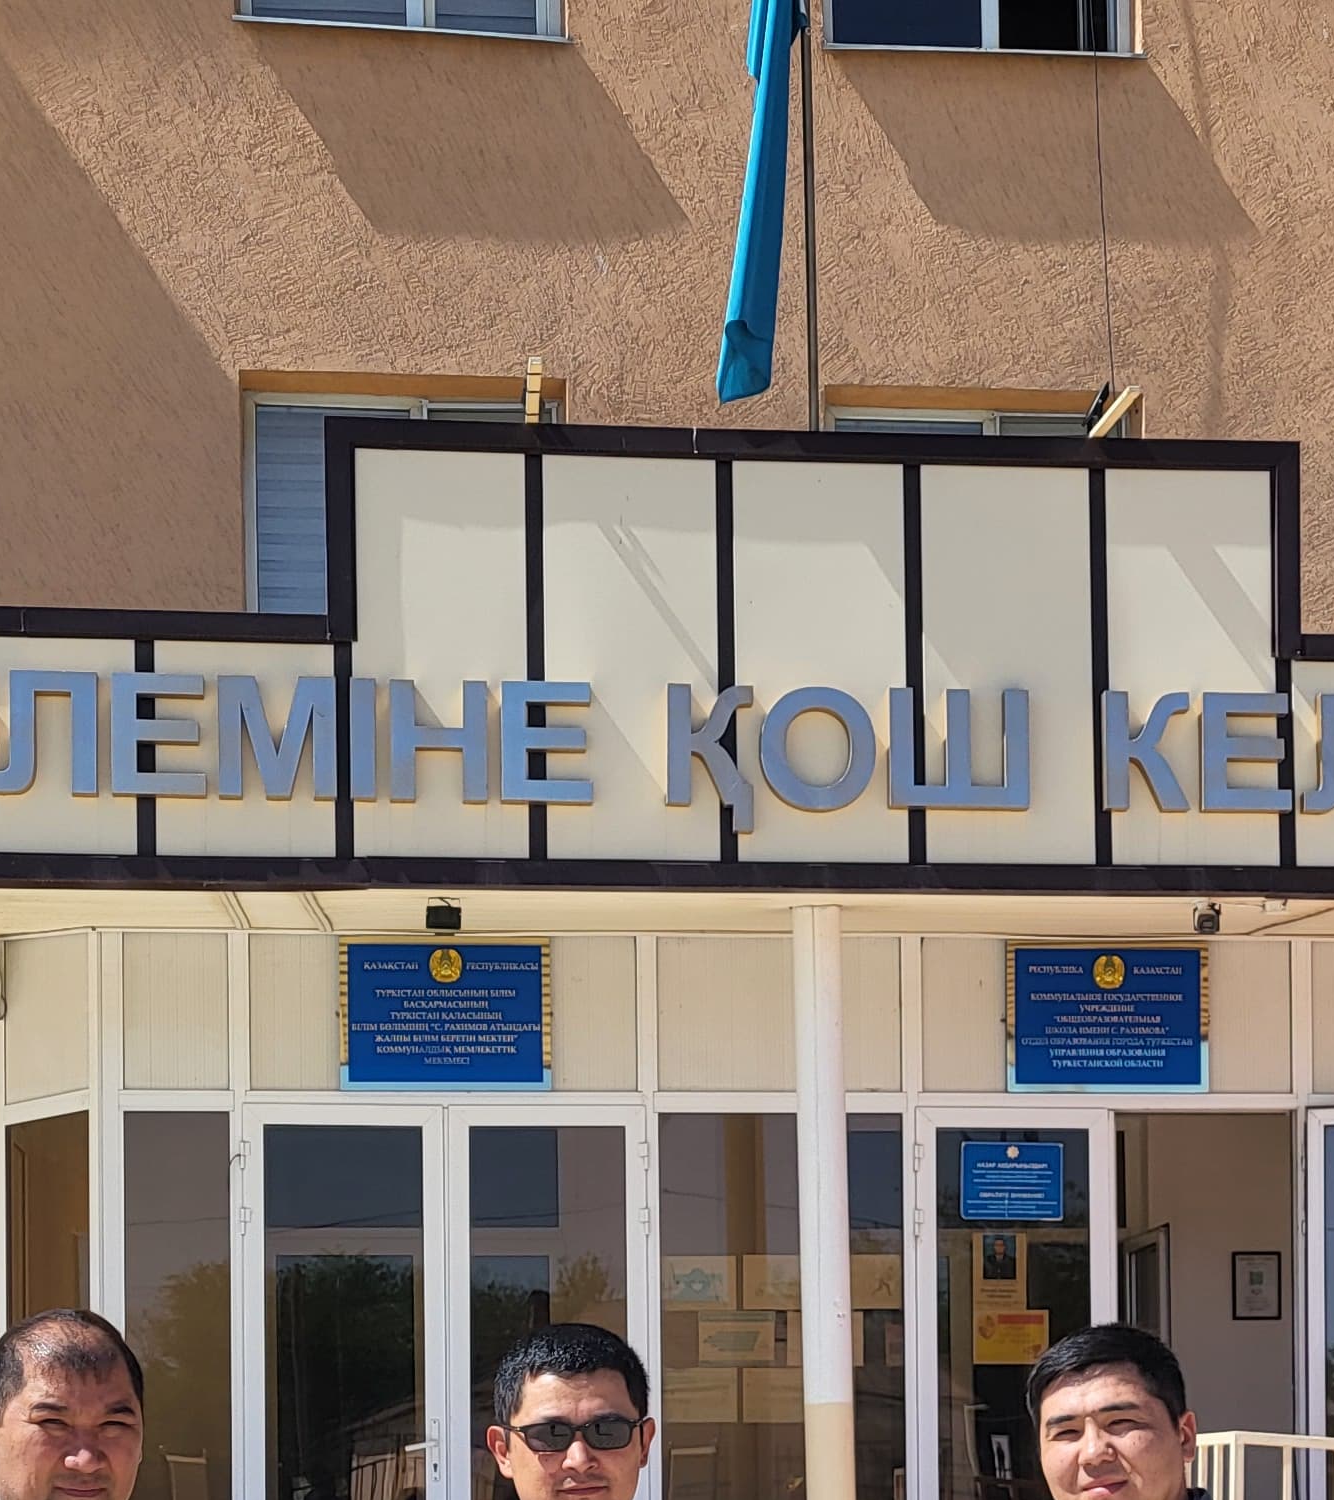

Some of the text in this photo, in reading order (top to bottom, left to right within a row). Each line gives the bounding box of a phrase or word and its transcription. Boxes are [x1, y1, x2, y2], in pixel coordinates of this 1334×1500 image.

[664, 681, 1029, 835] ҚОШ
[363, 961, 539, 973] ҚАЗАҚСТАН РЕСПУБЛИКАСЫ
[1028, 965, 1183, 975] РЕСПУБЛИКА КАЗАХСТАН
